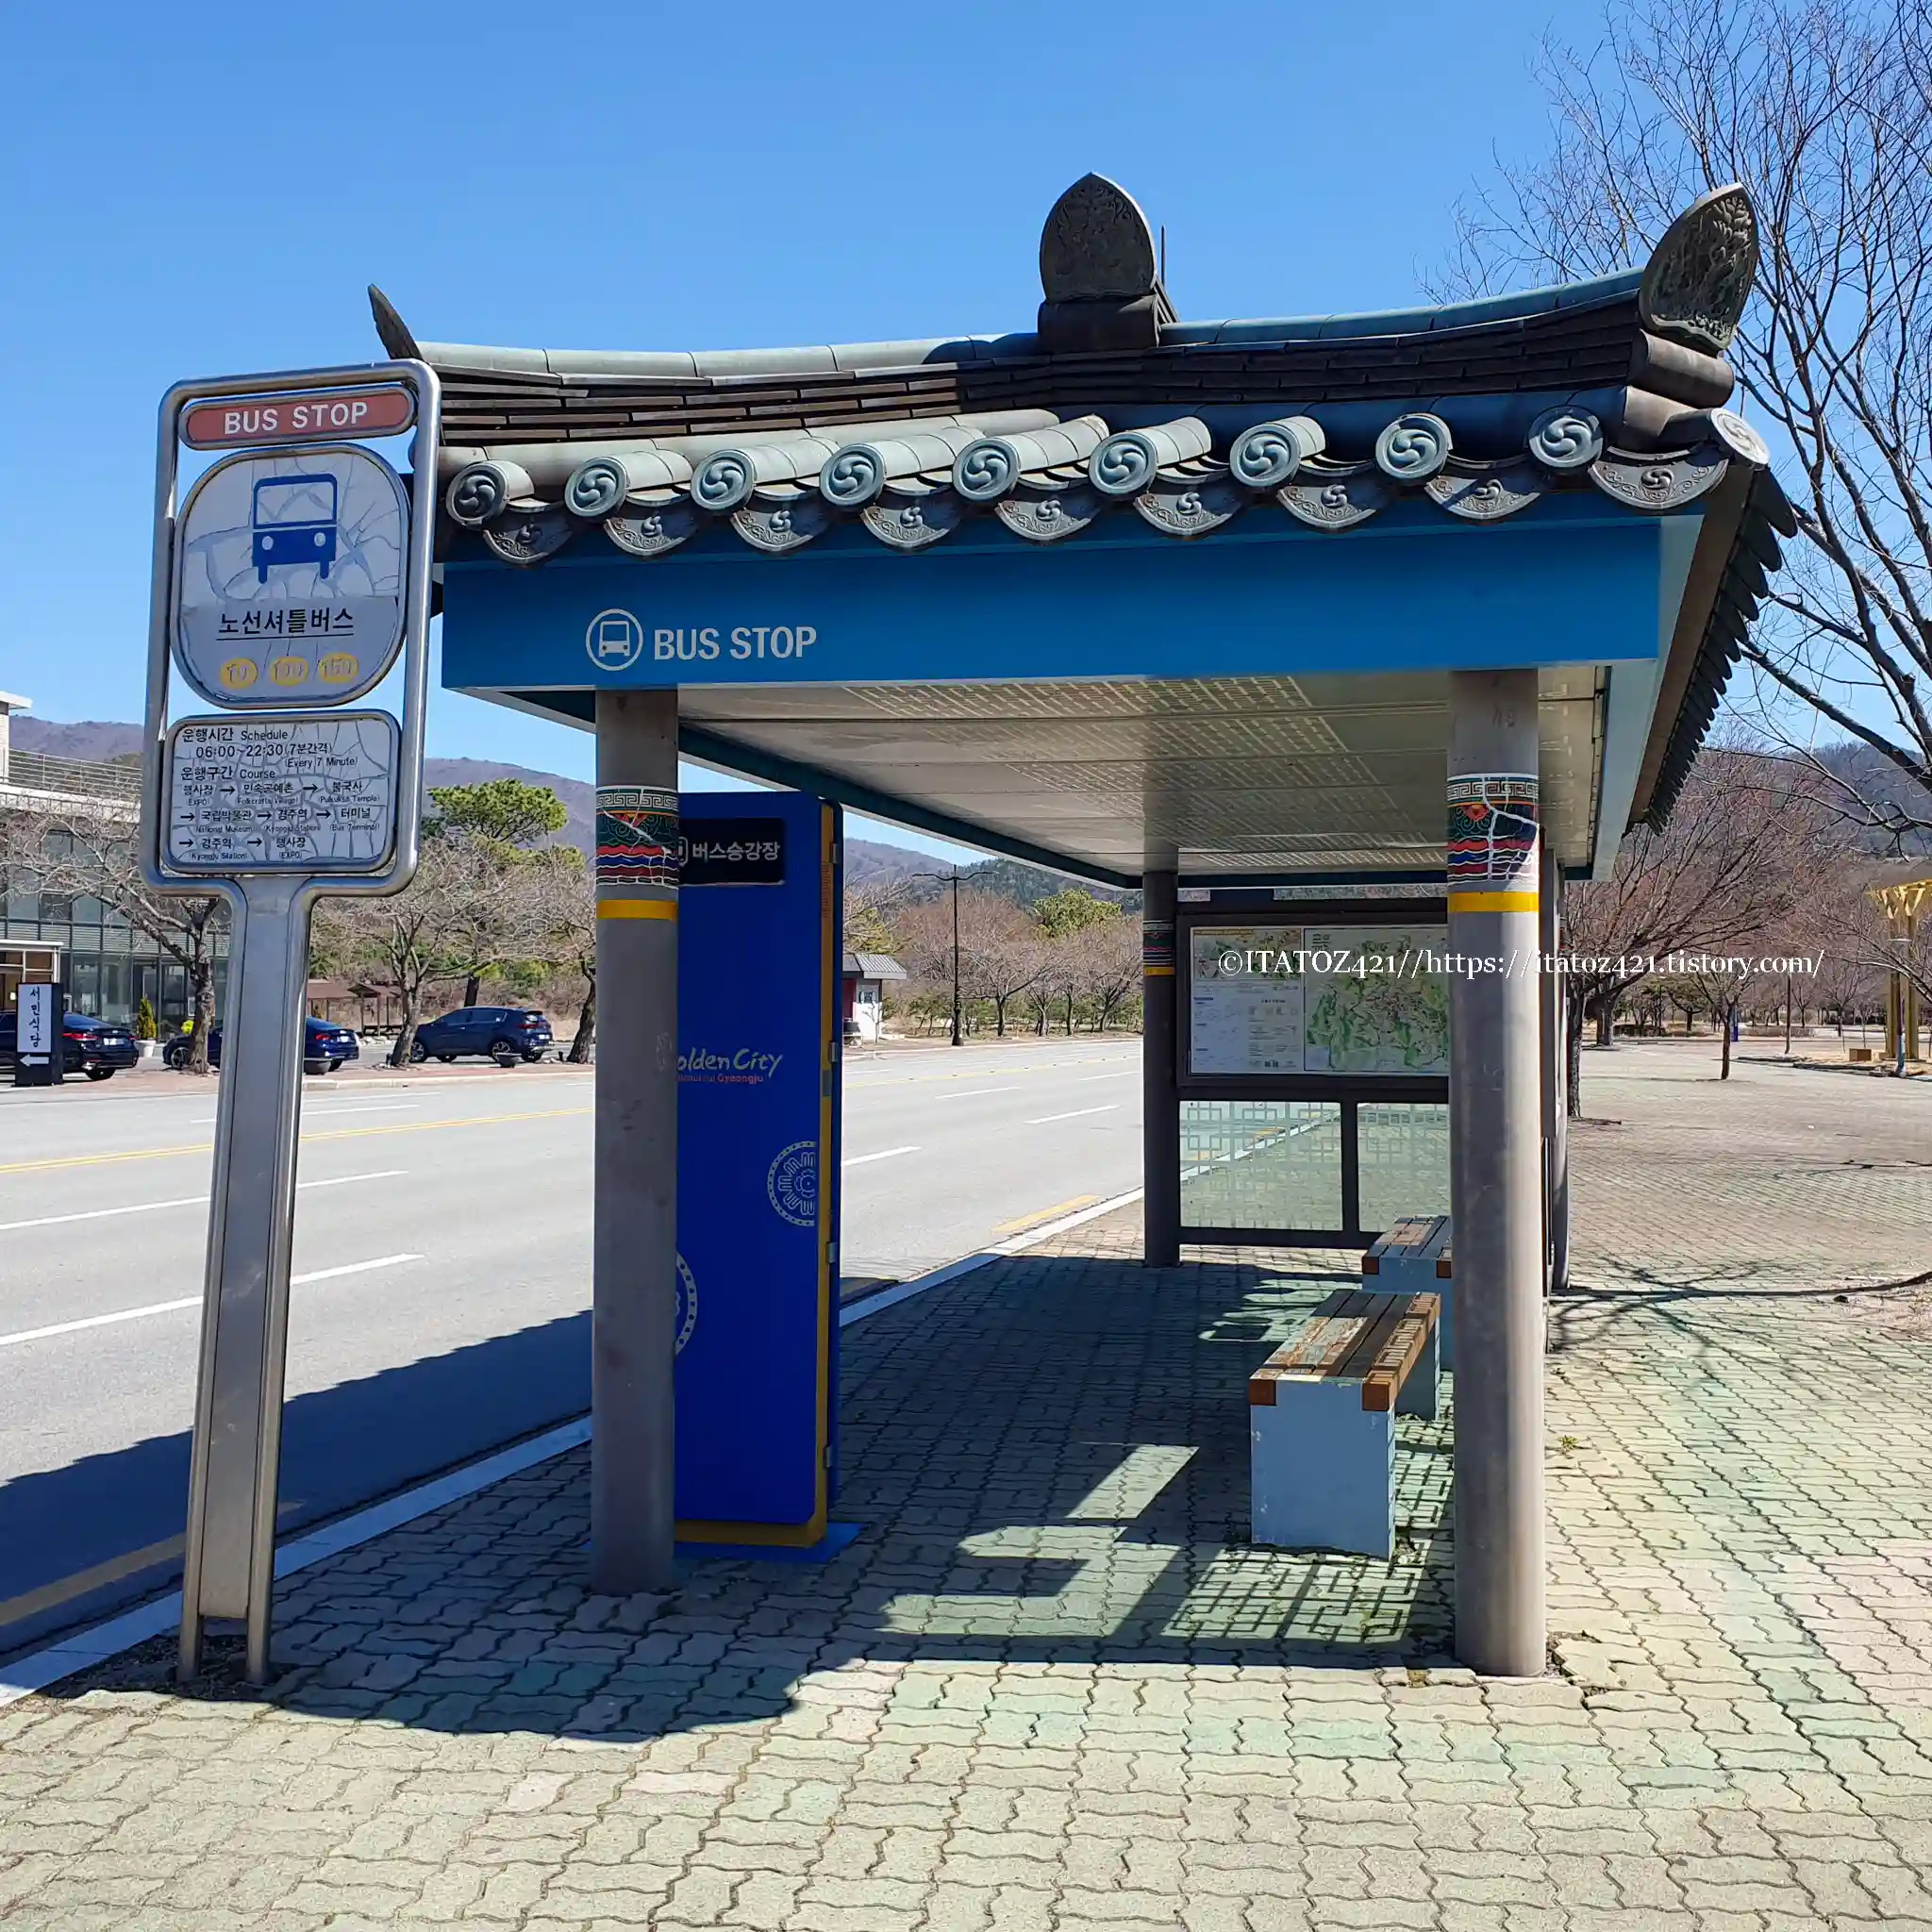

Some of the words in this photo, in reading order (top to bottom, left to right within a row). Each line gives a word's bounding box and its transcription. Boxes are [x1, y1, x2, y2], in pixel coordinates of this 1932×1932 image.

[225, 408, 279, 435] BUS
[291, 402, 368, 429] STOP
[218, 608, 355, 634] 노선셔틀버스
[654, 627, 720, 660] BUS
[729, 626, 817, 659] STOP
[182, 727, 234, 742] 운행시간
[241, 730, 289, 741] Schedule
[317, 758, 323, 766] 7
[180, 766, 234, 781] 운행구간
[240, 769, 276, 779] Course
[341, 808, 371, 819] 터미널
[691, 841, 781, 862] 버스승강장
[677, 1046, 730, 1073] olden
[733, 1047, 784, 1079] City
